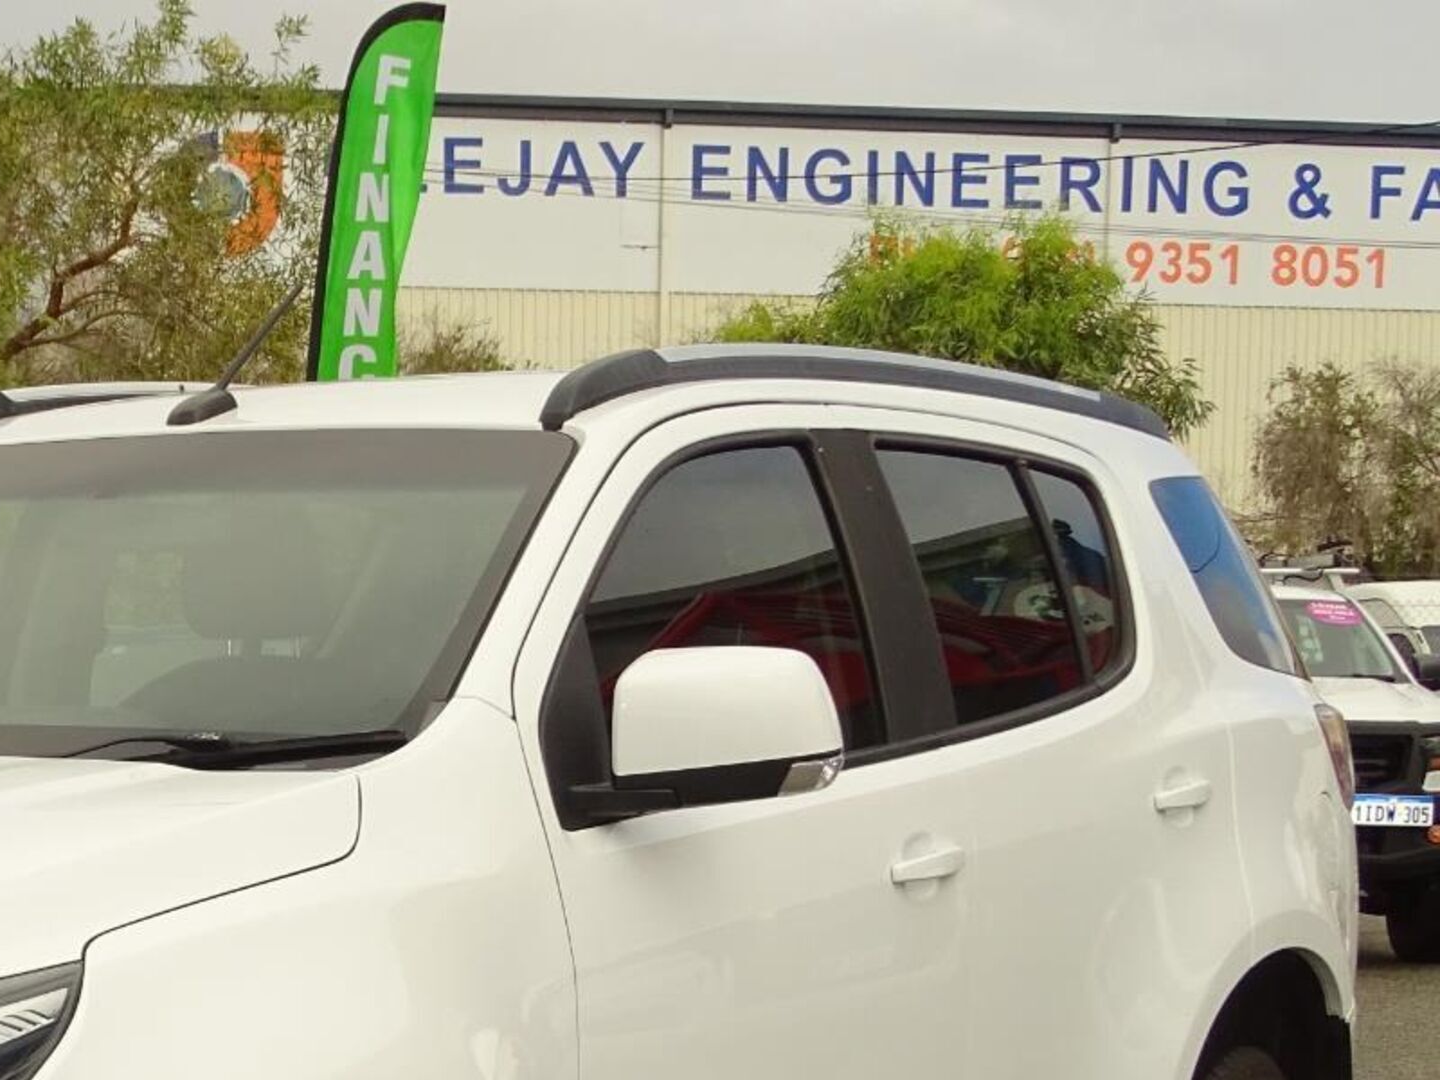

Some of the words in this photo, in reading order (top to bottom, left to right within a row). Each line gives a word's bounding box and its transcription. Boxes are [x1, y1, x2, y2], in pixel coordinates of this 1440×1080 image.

[422, 136, 644, 197] EJAY
[691, 143, 1250, 219] ENGINEERING
[1288, 162, 1331, 220] &
[1125, 239, 1240, 285] 9351
[1271, 243, 1386, 289] 8051
